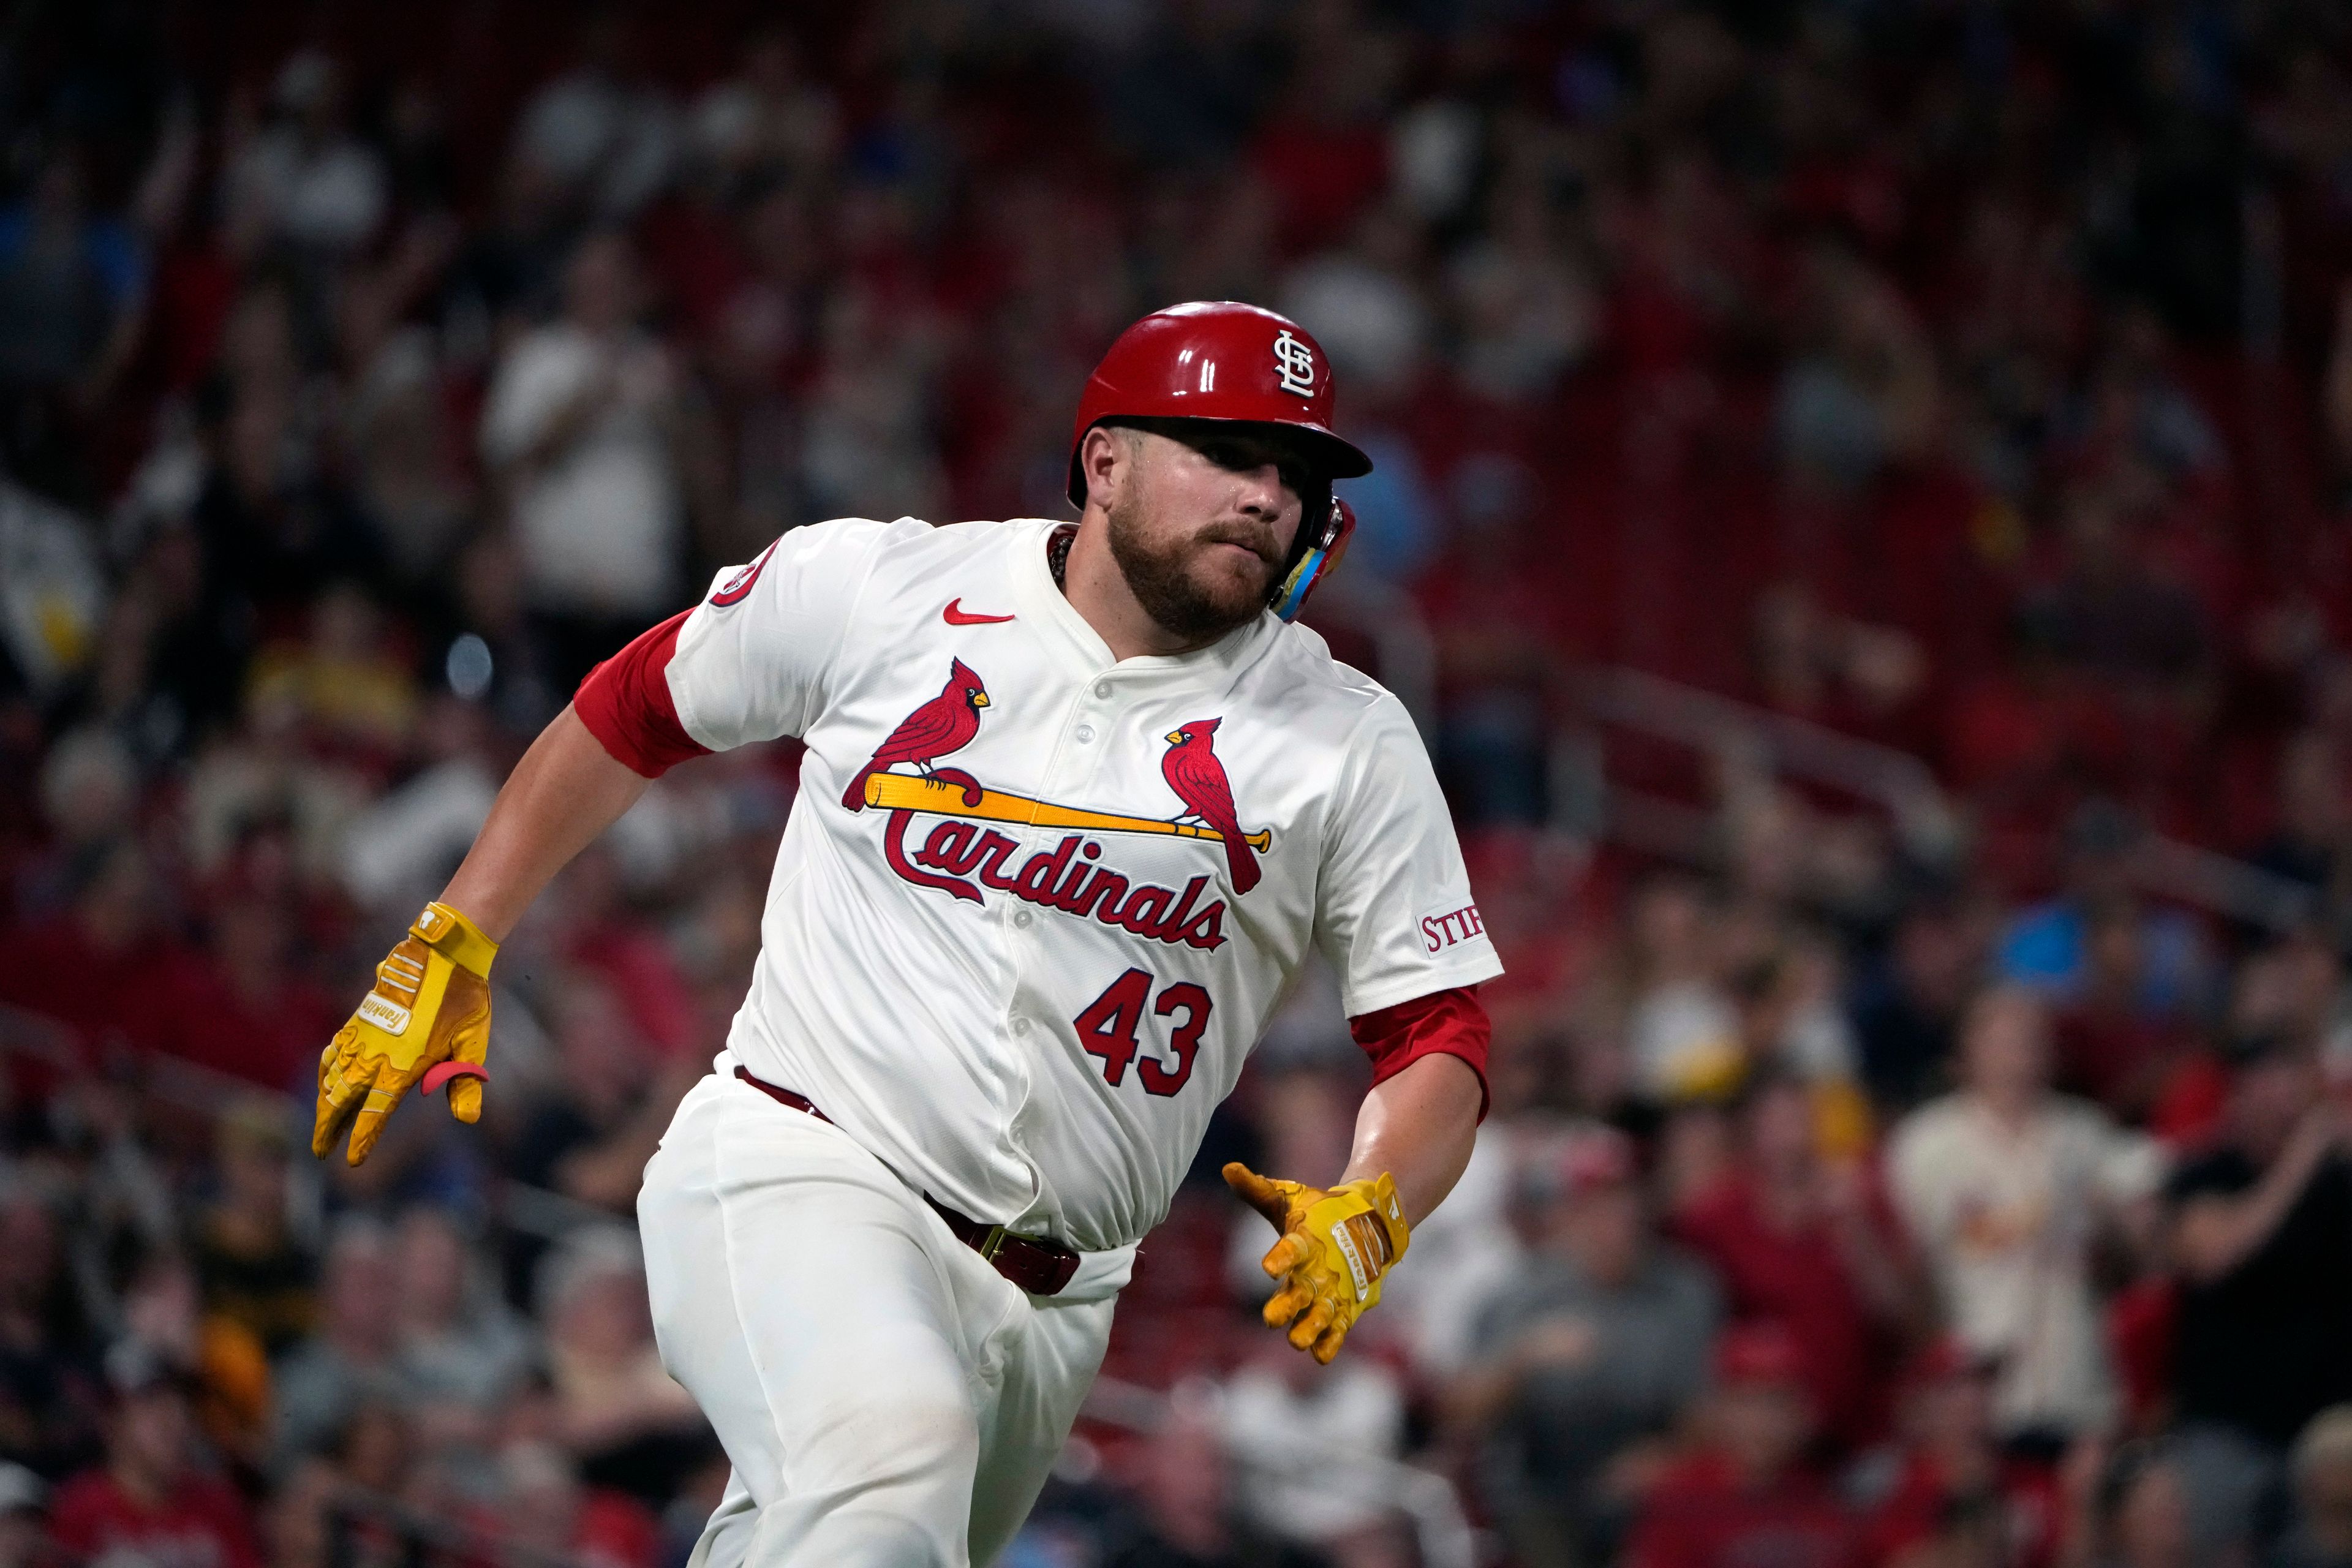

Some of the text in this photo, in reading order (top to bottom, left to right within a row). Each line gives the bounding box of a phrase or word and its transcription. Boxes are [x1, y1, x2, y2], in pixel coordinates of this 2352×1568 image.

[884, 810, 1228, 952] Cardinals
[362, 999, 407, 1030] Franklin
[1073, 967, 1213, 1098] 43
[1336, 1226, 1367, 1291] Franklin
